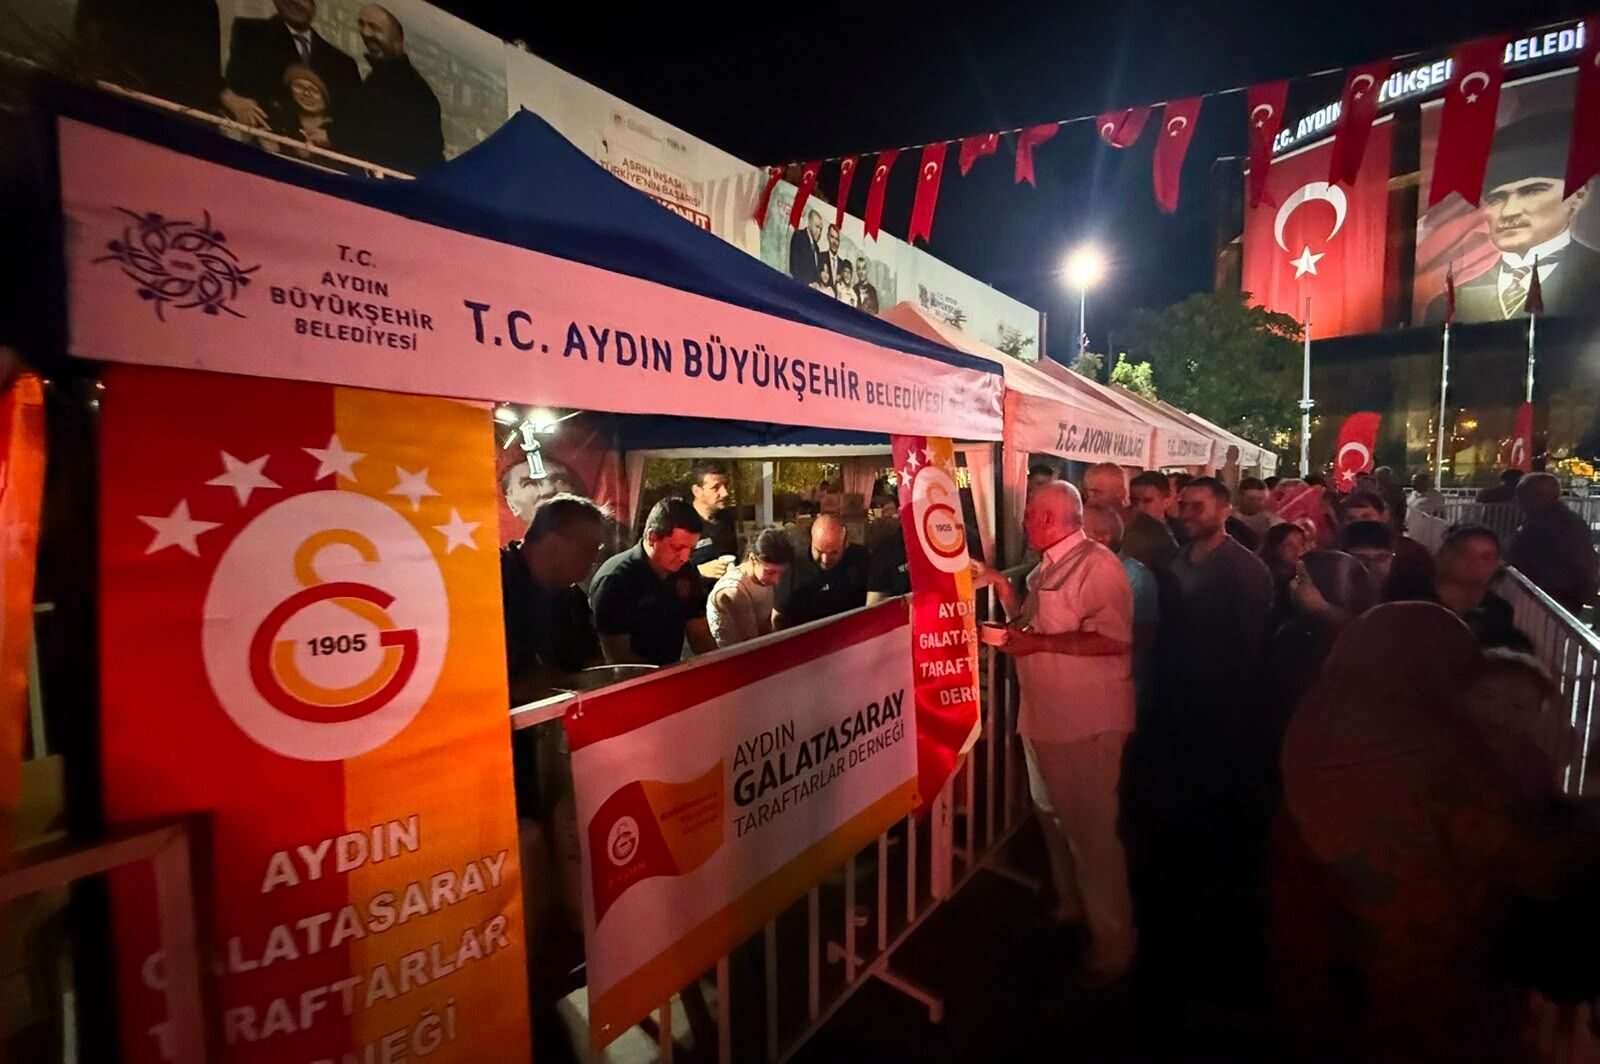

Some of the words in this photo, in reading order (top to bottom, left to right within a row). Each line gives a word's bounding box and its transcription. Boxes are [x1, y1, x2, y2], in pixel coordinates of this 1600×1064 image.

[1296, 100, 1343, 139] AYDIN
[336, 243, 377, 268] T.C.
[321, 270, 389, 297] AYDIN
[270, 286, 433, 331] BÜYÜKŞEHİR
[295, 317, 417, 351] BELEDİYESİ
[464, 299, 549, 354] T.C.
[562, 320, 672, 374] AYDIN
[682, 334, 860, 402] BÜYÜKŞEHİR
[1055, 422, 1077, 452] T.C.
[1078, 427, 1114, 455] AYDIN
[307, 634, 367, 656] 1905
[919, 627, 977, 650] GALATAS
[919, 657, 976, 679] TARAFT
[732, 719, 795, 772] AYDIN
[733, 689, 904, 807] GALATASARAY
[734, 757, 845, 838] TARAFTARLAR
[848, 719, 904, 768] DERNEĞİ
[261, 815, 420, 894] AYDIN
[141, 849, 509, 992] GLATASARAY
[146, 914, 511, 1062] TRAFTARLAR
